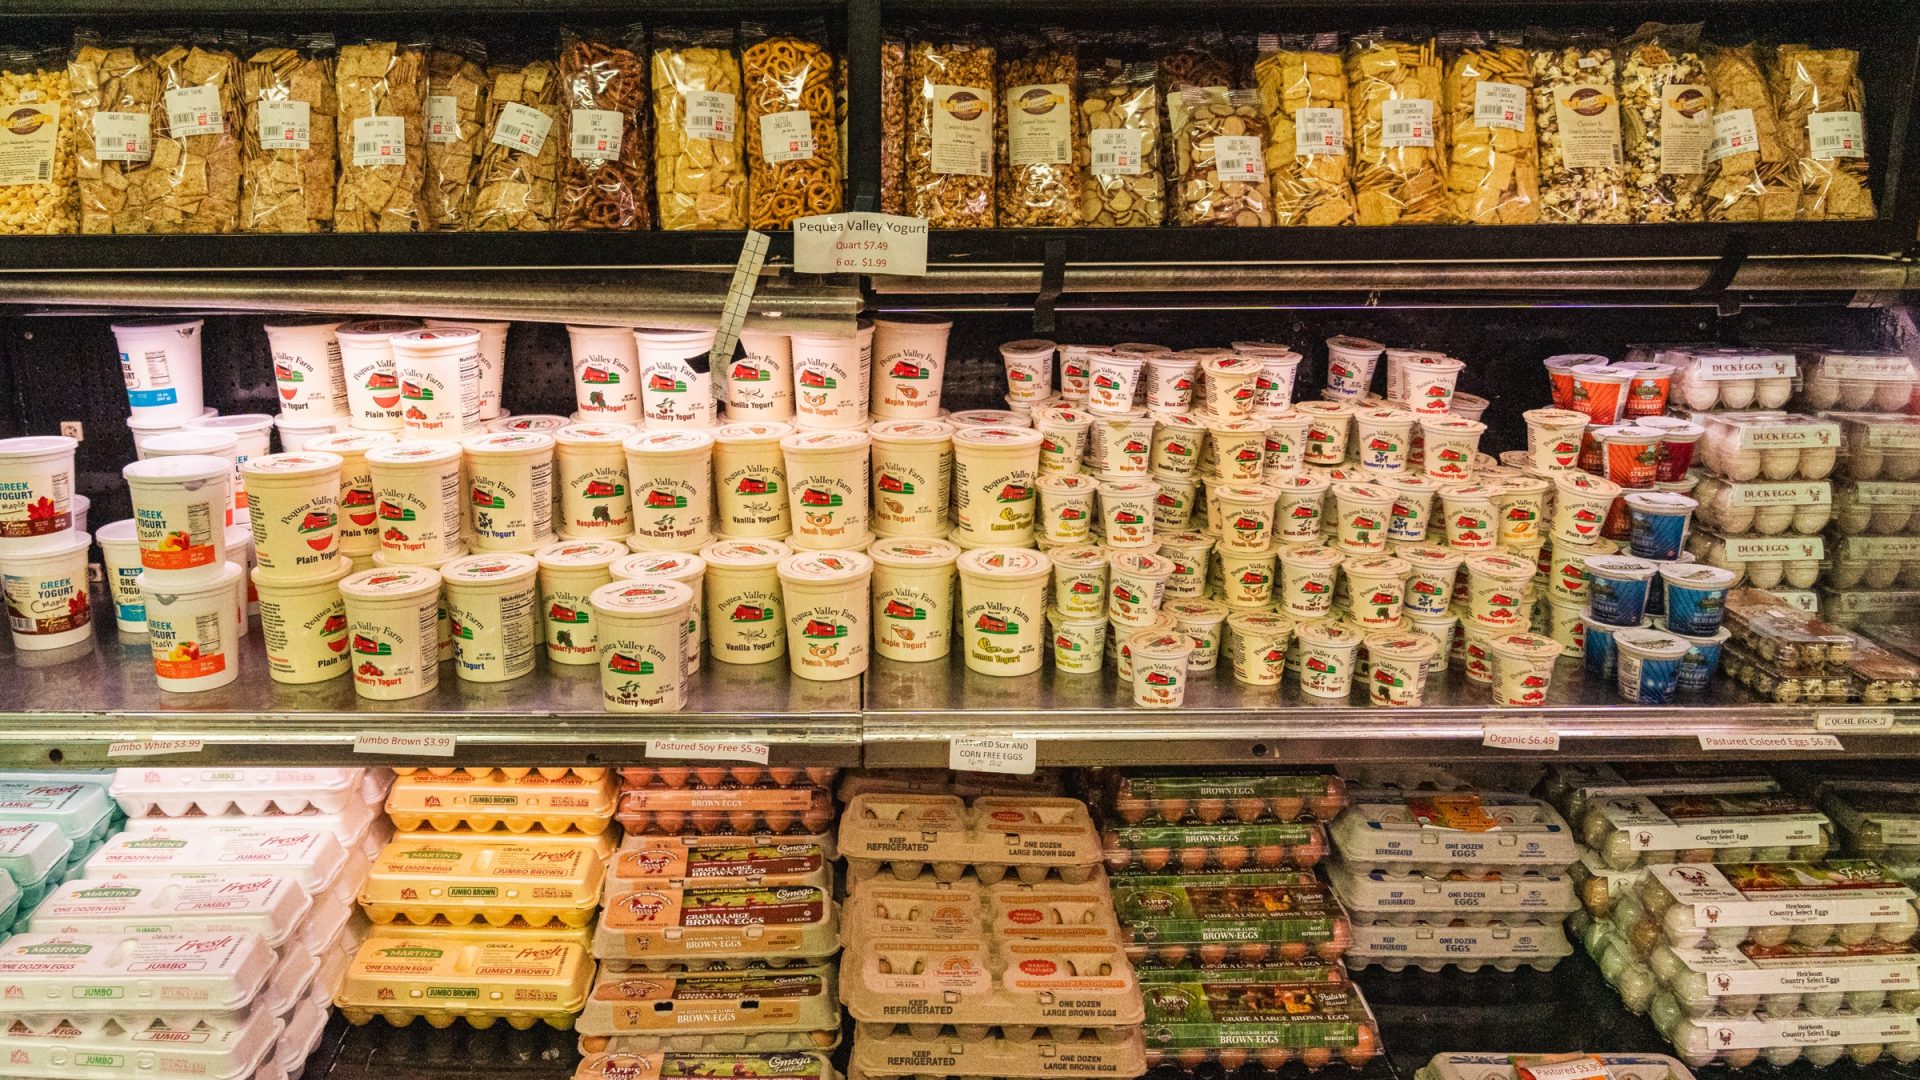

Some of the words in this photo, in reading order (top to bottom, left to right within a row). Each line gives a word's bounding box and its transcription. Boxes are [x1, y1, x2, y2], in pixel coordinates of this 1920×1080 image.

[799, 222, 844, 235] Pequea
[847, 220, 882, 233] Valley
[886, 221, 926, 235] Yogurt
[836, 241, 861, 250] Quart
[864, 240, 888, 250] $7.49
[836, 258, 841, 266] 6
[863, 258, 887, 267] $1.99
[903, 349, 925, 359] Valley
[590, 355, 610, 366] Valley
[612, 358, 630, 373] Farm
[1712, 364, 1738, 372] DUCK
[1740, 363, 1762, 371] EGGS
[425, 373, 445, 390] Farm
[751, 401, 774, 410] Yogurt
[906, 398, 928, 407] Yogurt
[606, 404, 627, 412] Yogurt
[366, 410, 384, 418] Plain
[656, 413, 674, 422] Cherry
[676, 412, 695, 421] Yogurt
[421, 421, 443, 429] Yogurt
[1753, 433, 1779, 441] DUCK
[1781, 432, 1805, 440] EGGS
[723, 467, 745, 486] Pequea
[747, 465, 769, 475] Valley
[771, 466, 787, 482] Farm
[655, 478, 679, 487] Valley
[681, 482, 697, 497] Farm
[811, 475, 833, 485] Valley
[835, 479, 853, 495] Farm
[982, 475, 1009, 494] Pequea
[1745, 490, 1770, 498] DUCK
[138, 510, 163, 520] GREEK
[281, 503, 311, 526] Pequea
[732, 516, 755, 524] Vanilla
[757, 514, 780, 524] Yogurt
[138, 520, 166, 530] YOGURT
[653, 528, 674, 538] Cherry
[676, 527, 695, 537] Yogurt
[1738, 544, 1764, 552] DUCK
[1766, 544, 1789, 552] EGGS
[296, 556, 318, 565] Plain
[40, 578, 71, 590] GREEK
[38, 586, 74, 598] YOGURT
[717, 592, 741, 612] Pequea
[743, 592, 767, 602] Valley
[769, 593, 783, 607] Farm
[895, 588, 920, 600] Valley
[921, 593, 937, 609] Farm
[813, 607, 838, 618] Valley
[841, 609, 857, 626] Farm
[985, 602, 1012, 612] Valley
[1013, 609, 1030, 624] Farm
[383, 627, 404, 645] Farm
[725, 642, 748, 652] Vanilla
[750, 641, 775, 650] Yogurt
[881, 637, 901, 649] Maple
[902, 641, 927, 650] Yogurt
[618, 641, 646, 650] Valley
[647, 645, 667, 662] Farm
[318, 657, 337, 668] Plain
[1154, 663, 1172, 671] Valley
[377, 677, 402, 687] Yogurt
[617, 696, 638, 707] Cherry
[640, 695, 664, 706] Yogurt
[1831, 717, 1855, 725] QUAIL
[359, 736, 388, 744] Jumbo
[392, 737, 420, 746] Brown
[424, 738, 450, 747] $3.99
[1490, 734, 1527, 745] Organic
[1528, 736, 1554, 744] $6.49
[1706, 738, 1748, 746] Pastured
[1750, 737, 1786, 746] Colored
[1788, 738, 1809, 748] Eggs
[1811, 738, 1837, 746] $6.99
[110, 743, 141, 752] Jumbo
[145, 741, 171, 750] White
[174, 740, 200, 748] $3.99
[656, 742, 696, 750] Pastured
[699, 744, 715, 752] Soy
[741, 744, 766, 755] $5.99
[960, 750, 981, 758] CORN
[472, 796, 493, 804] JUMBO
[494, 796, 515, 804] BROWN
[133, 840, 182, 849] MARTIN'S
[777, 843, 812, 853] Omega
[866, 843, 929, 852] REFRIGERATED
[1451, 850, 1476, 858] EGGS
[1839, 866, 1881, 880] Free
[450, 888, 472, 896] JUMBO
[473, 888, 496, 896] BROWN
[1454, 898, 1479, 906] EGGS
[31, 945, 87, 954] MARTIN'S
[390, 949, 440, 958] MARTIN'S
[516, 948, 562, 960] Fresh
[19, 962, 49, 970] DOZEN
[145, 962, 187, 970] JUMBO
[365, 964, 382, 972] ONE
[382, 964, 410, 972] DOZEN
[412, 964, 432, 972] EGGS
[480, 967, 512, 976] JUMBO
[515, 968, 550, 976] BROWN
[83, 988, 112, 997] JUMBO
[429, 988, 452, 997] JUMBO
[453, 988, 477, 998] BROWN
[908, 999, 928, 1007] KEEP
[1058, 1000, 1074, 1008] ONE
[883, 1006, 953, 1015] REFRIGERATED
[1042, 1009, 1067, 1017] LARGE
[1069, 1009, 1095, 1017] BROWN
[86, 1056, 113, 1065] JUMBO
[768, 1056, 812, 1069] Omega
[600, 1066, 641, 1076] LAPP'S
[773, 1065, 805, 1073] Fortified
[1536, 1065, 1576, 1076] Pastured
[1577, 1062, 1602, 1074] $5.99
